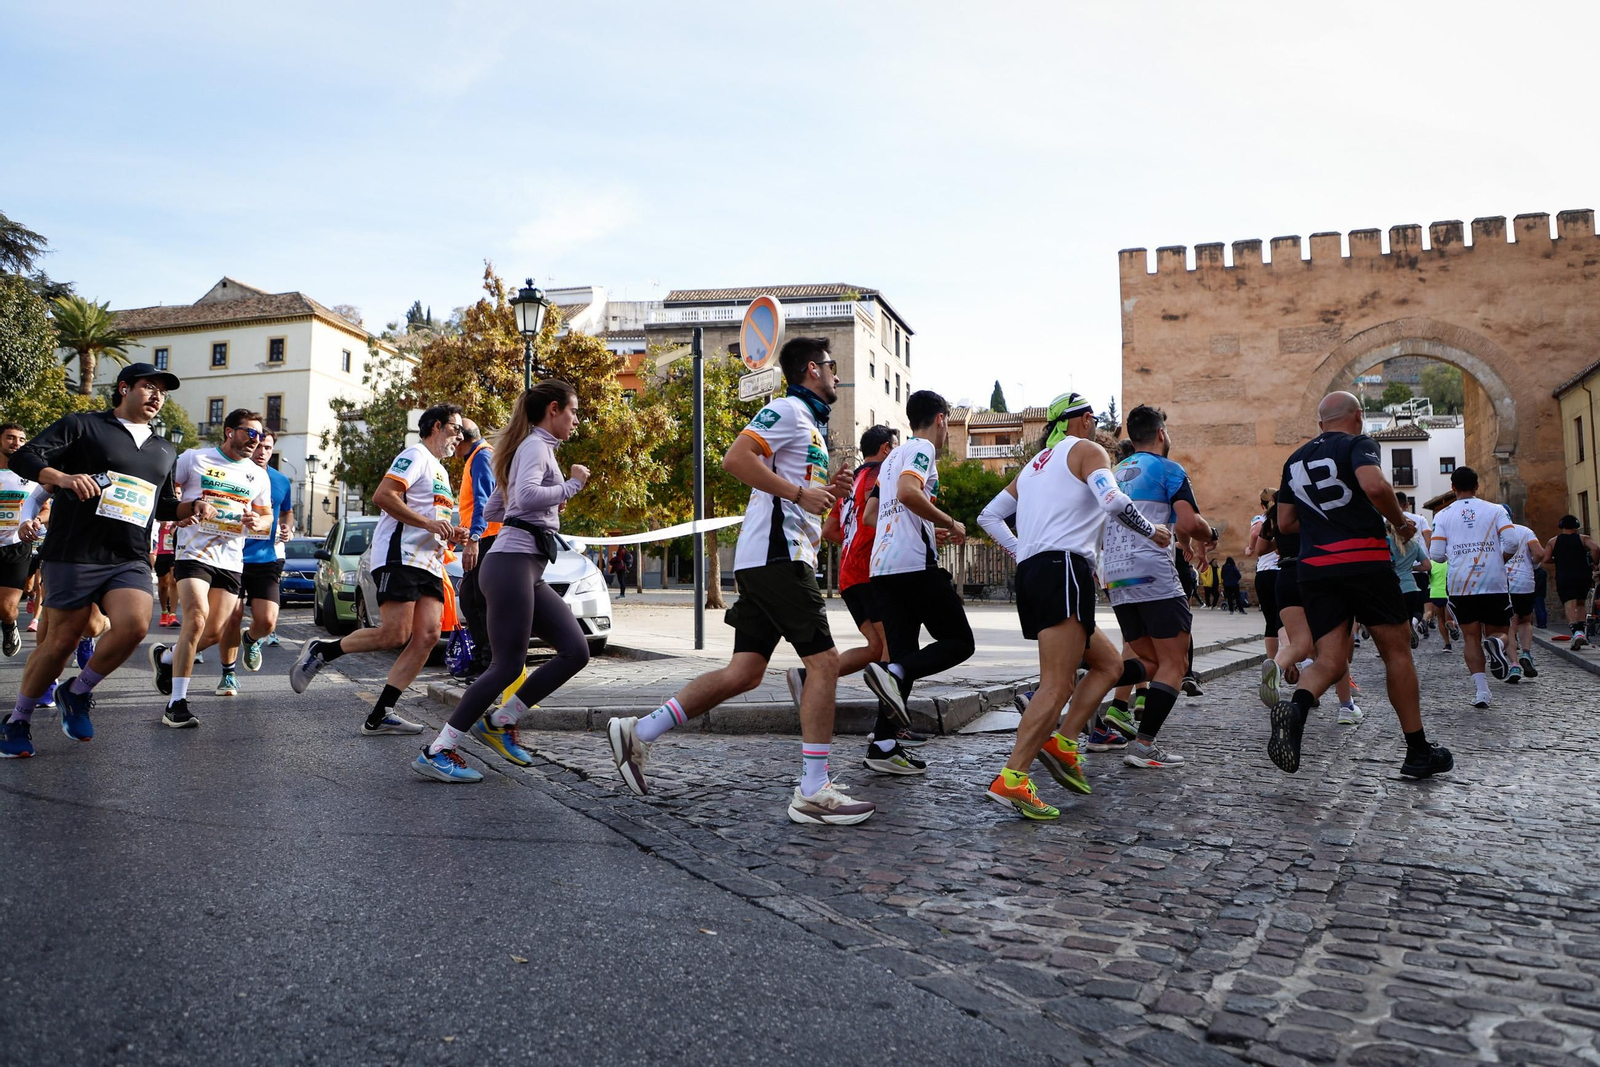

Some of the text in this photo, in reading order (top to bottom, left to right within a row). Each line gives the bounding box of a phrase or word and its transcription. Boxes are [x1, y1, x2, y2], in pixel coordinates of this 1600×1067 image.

[202, 479, 250, 496] CARRERA
[113, 487, 148, 507] 556
[1452, 540, 1495, 550] UNIVERSIDAD
[1461, 546, 1496, 555] GRANADA
